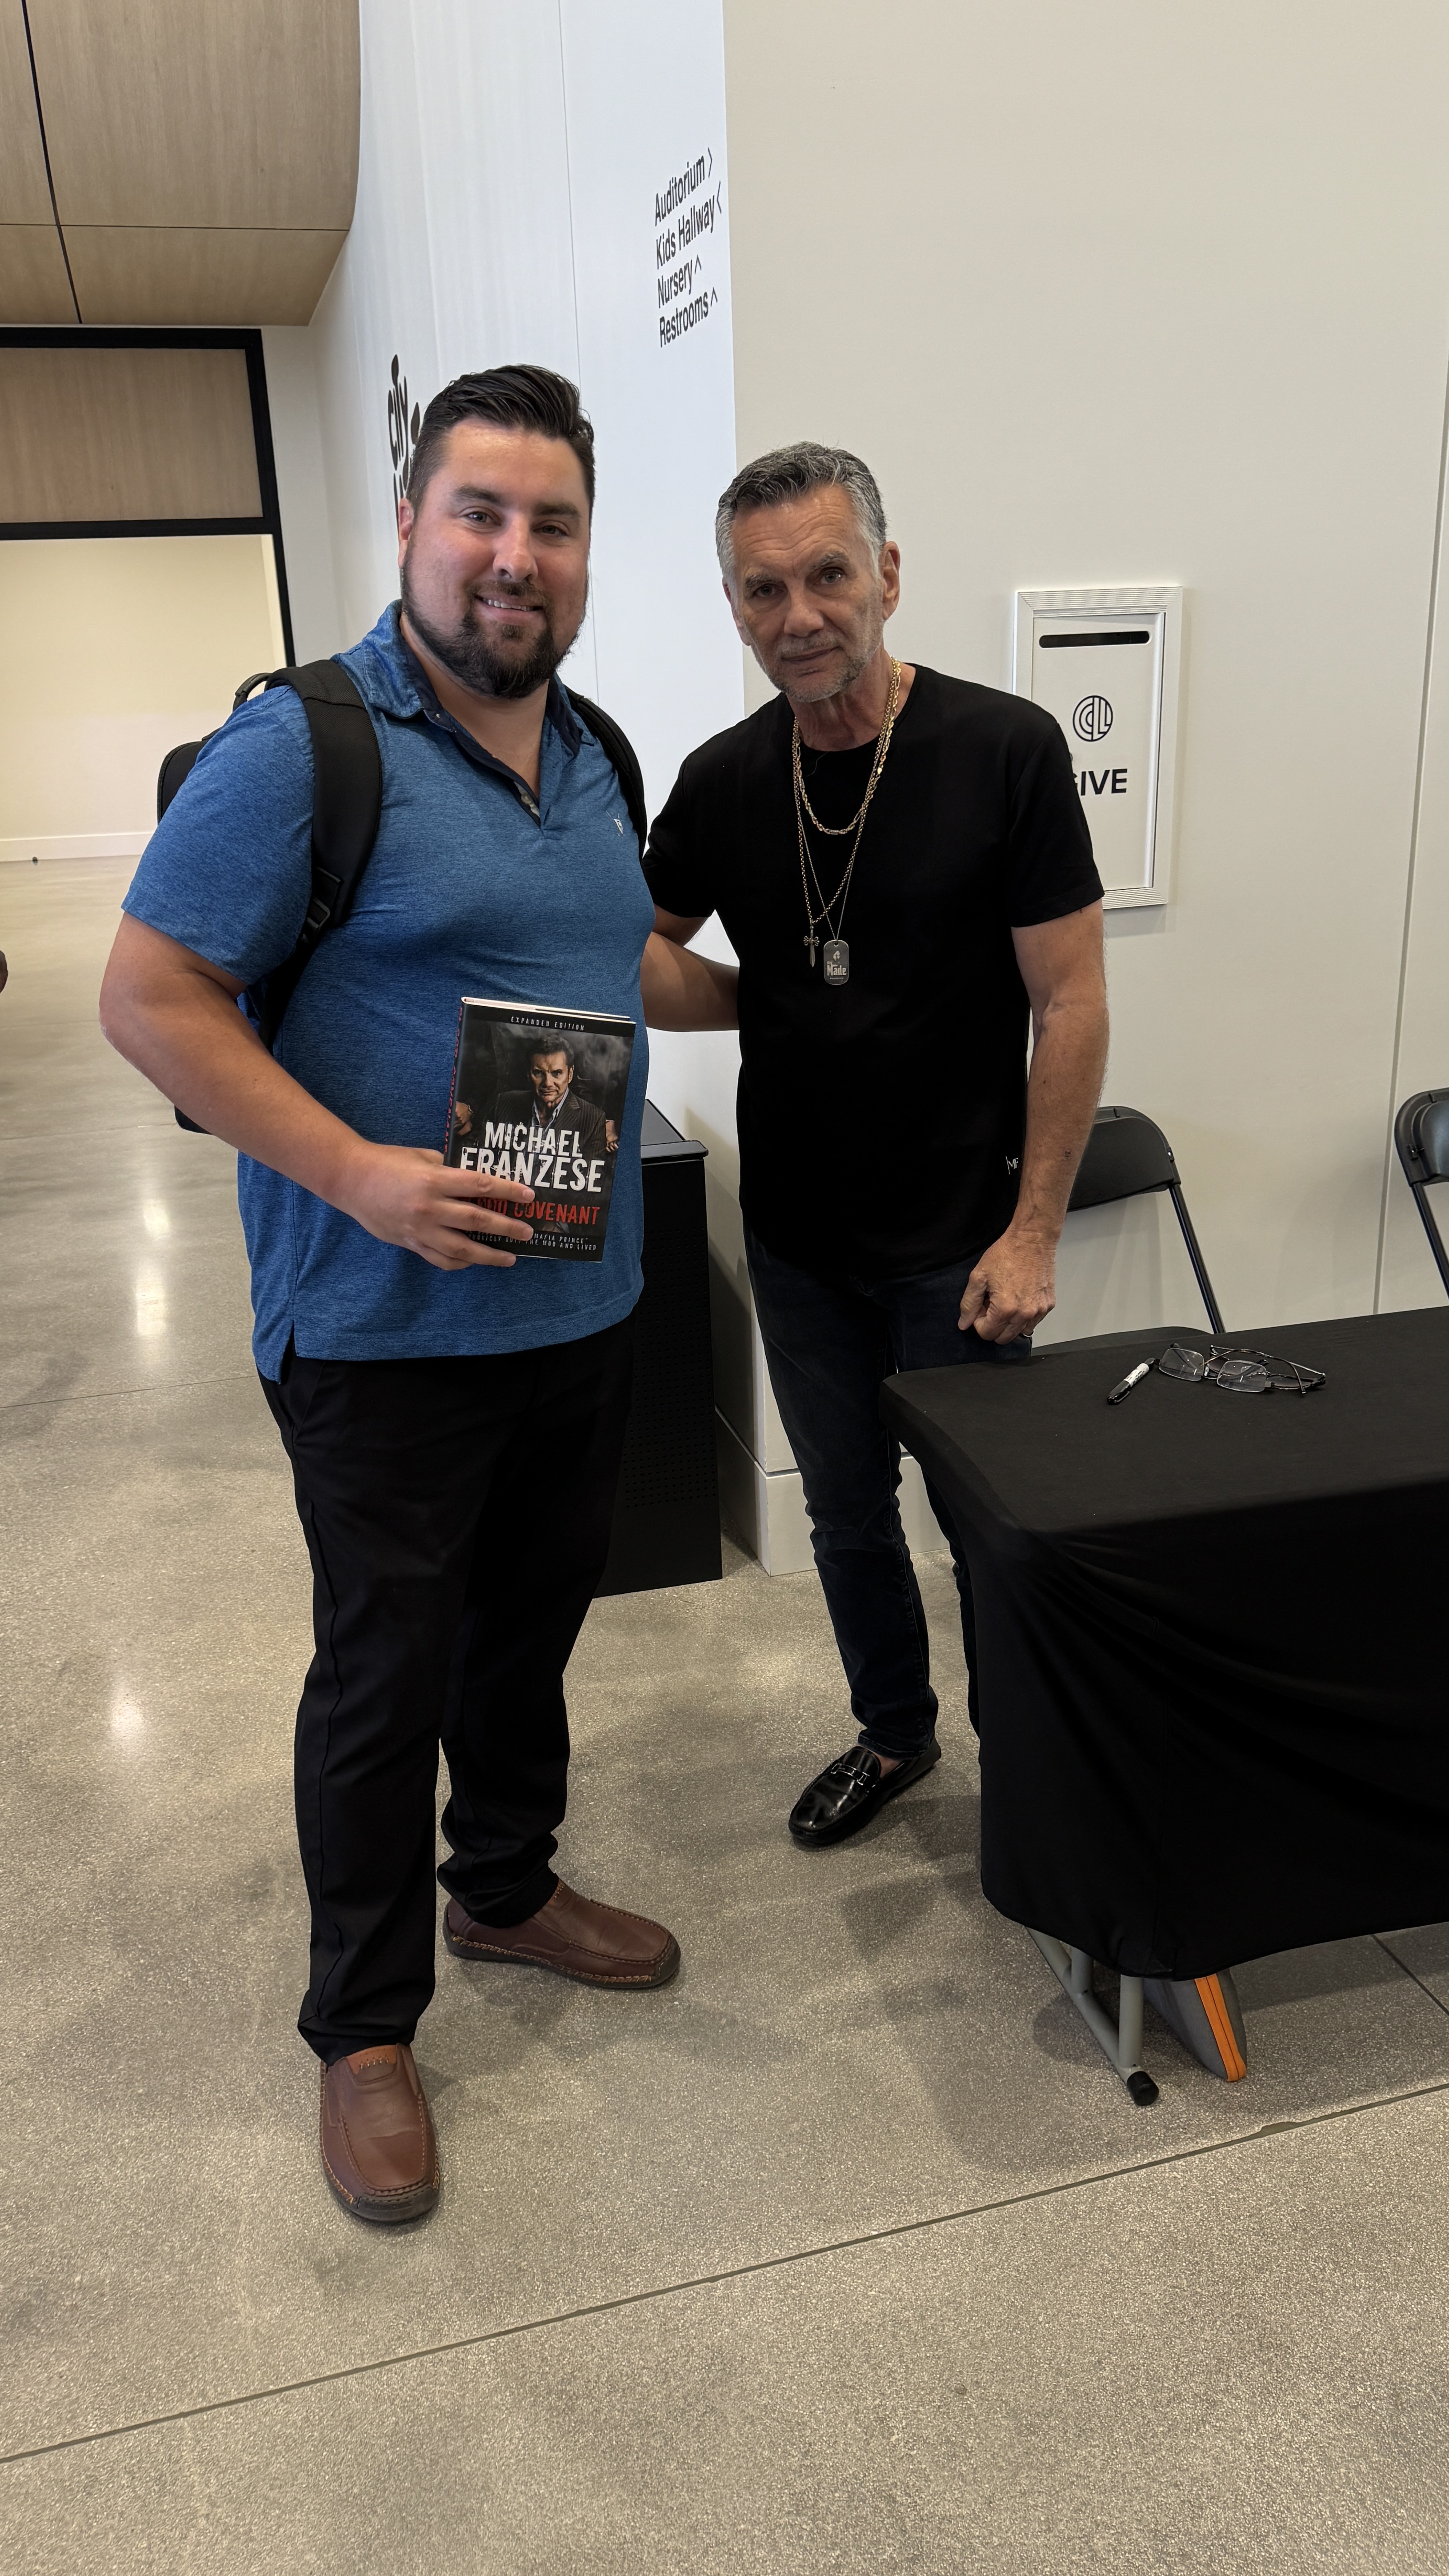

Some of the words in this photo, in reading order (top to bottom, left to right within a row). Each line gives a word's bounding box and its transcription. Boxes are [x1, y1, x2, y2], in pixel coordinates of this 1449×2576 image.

[655, 155, 705, 226] Auditorium
[656, 228, 676, 270] Kids
[678, 195, 715, 251] Hallway
[658, 259, 693, 308] Nursery
[659, 291, 709, 348] Restrooms
[511, 1016, 550, 1027] EXPANDED
[554, 1021, 584, 1031] EDITION
[484, 1121, 583, 1158] MICHAEL
[460, 1147, 605, 1192] FRANZESE
[514, 1201, 600, 1225] COVENANT
